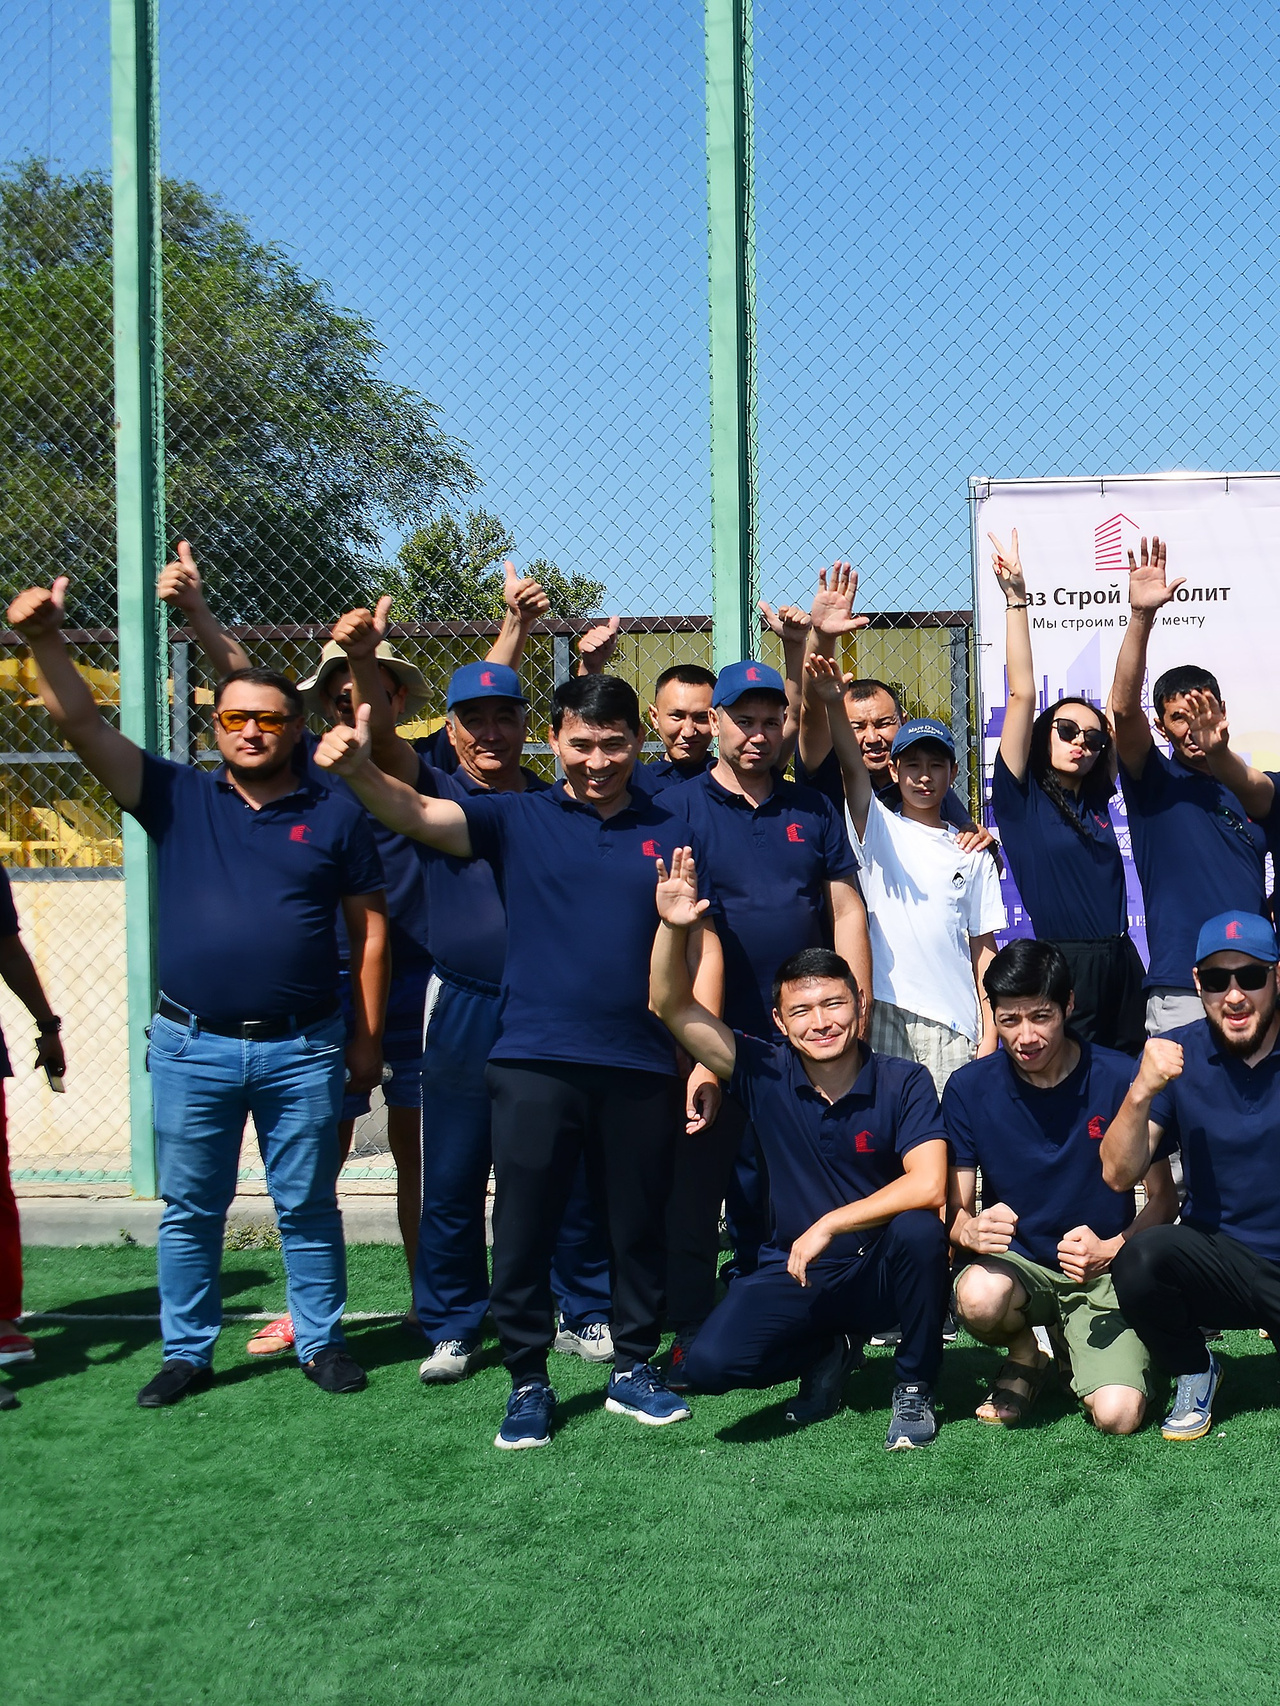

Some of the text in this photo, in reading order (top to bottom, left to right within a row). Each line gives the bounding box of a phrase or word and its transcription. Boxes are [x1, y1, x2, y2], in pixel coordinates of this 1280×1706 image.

[1025, 584, 1230, 610] аз Строй олит
[1033, 617, 1057, 629] Мы
[1061, 618, 1114, 632] строим
[1162, 616, 1206, 628] мечту
